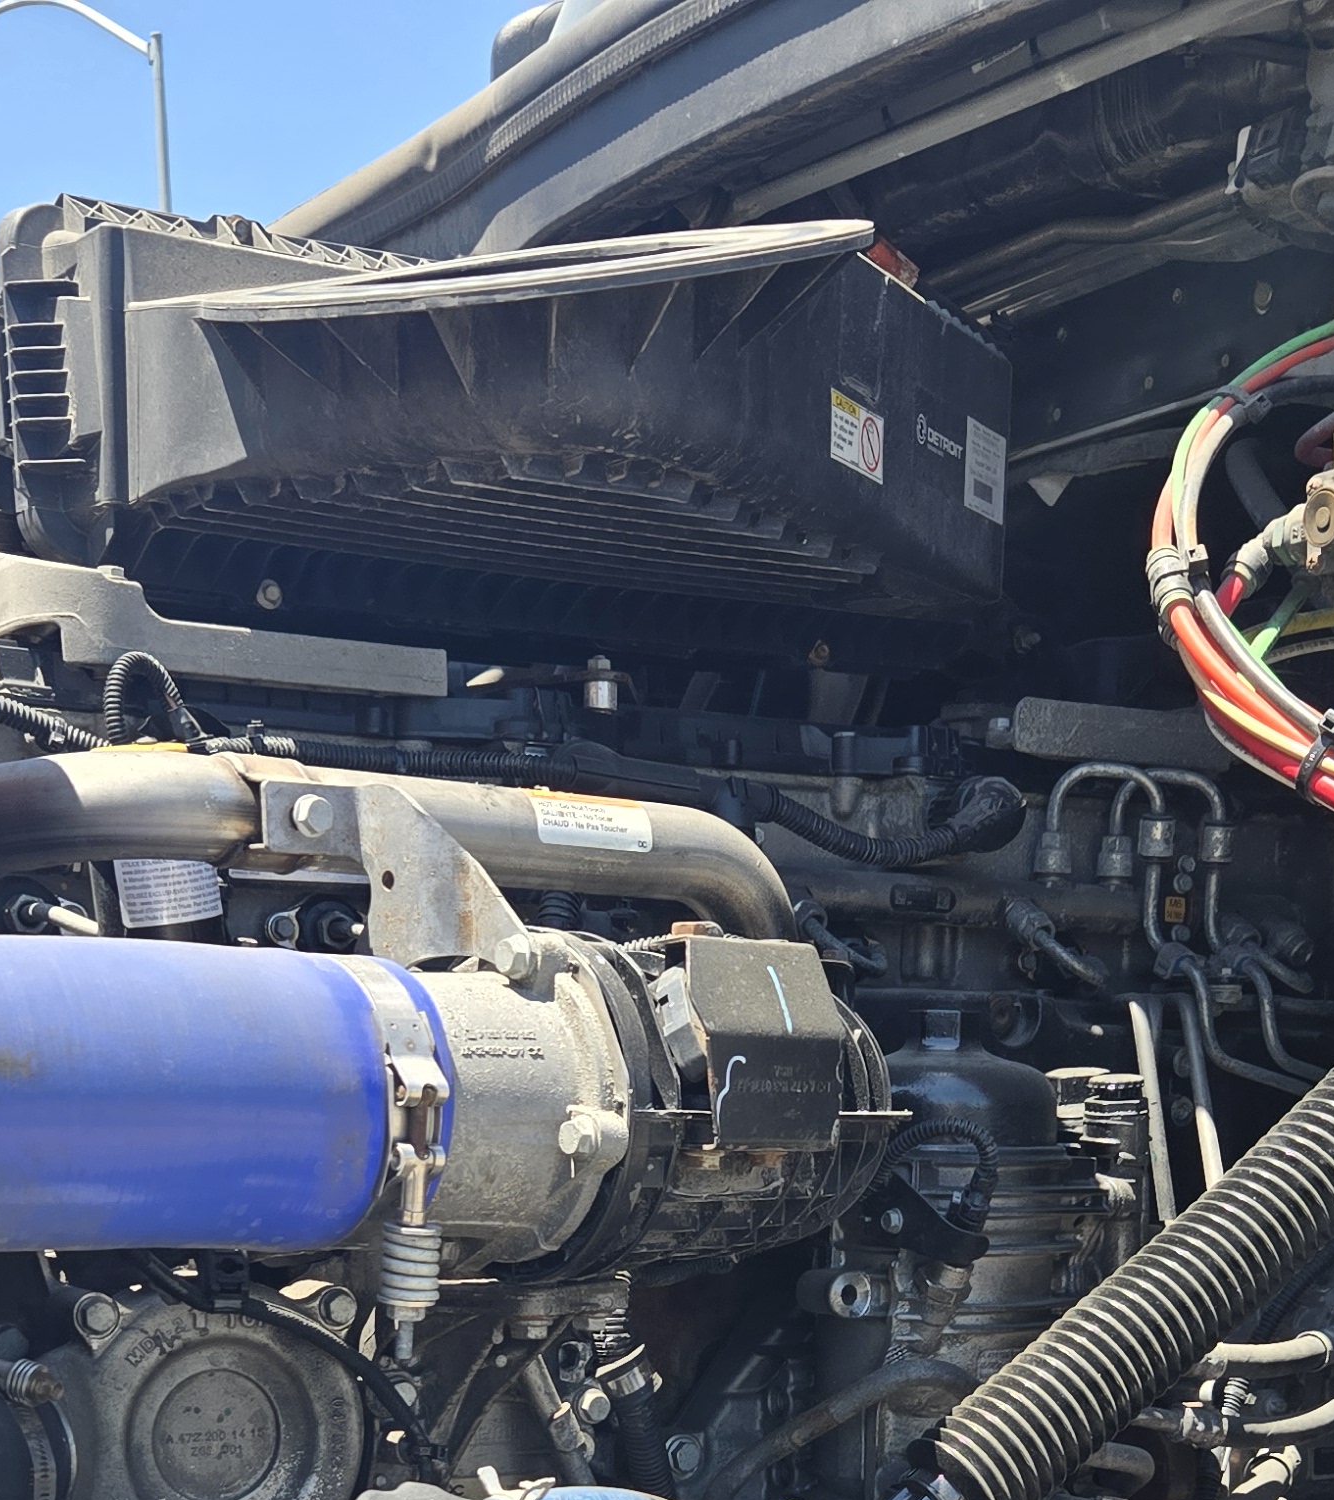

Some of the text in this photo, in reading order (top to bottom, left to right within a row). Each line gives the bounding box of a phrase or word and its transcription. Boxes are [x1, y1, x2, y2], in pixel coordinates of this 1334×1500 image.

[927, 427, 963, 459] DETROIT
[543, 818, 628, 834] CHAUD Ne Pas Toucher
[637, 840, 648, 849] DC
